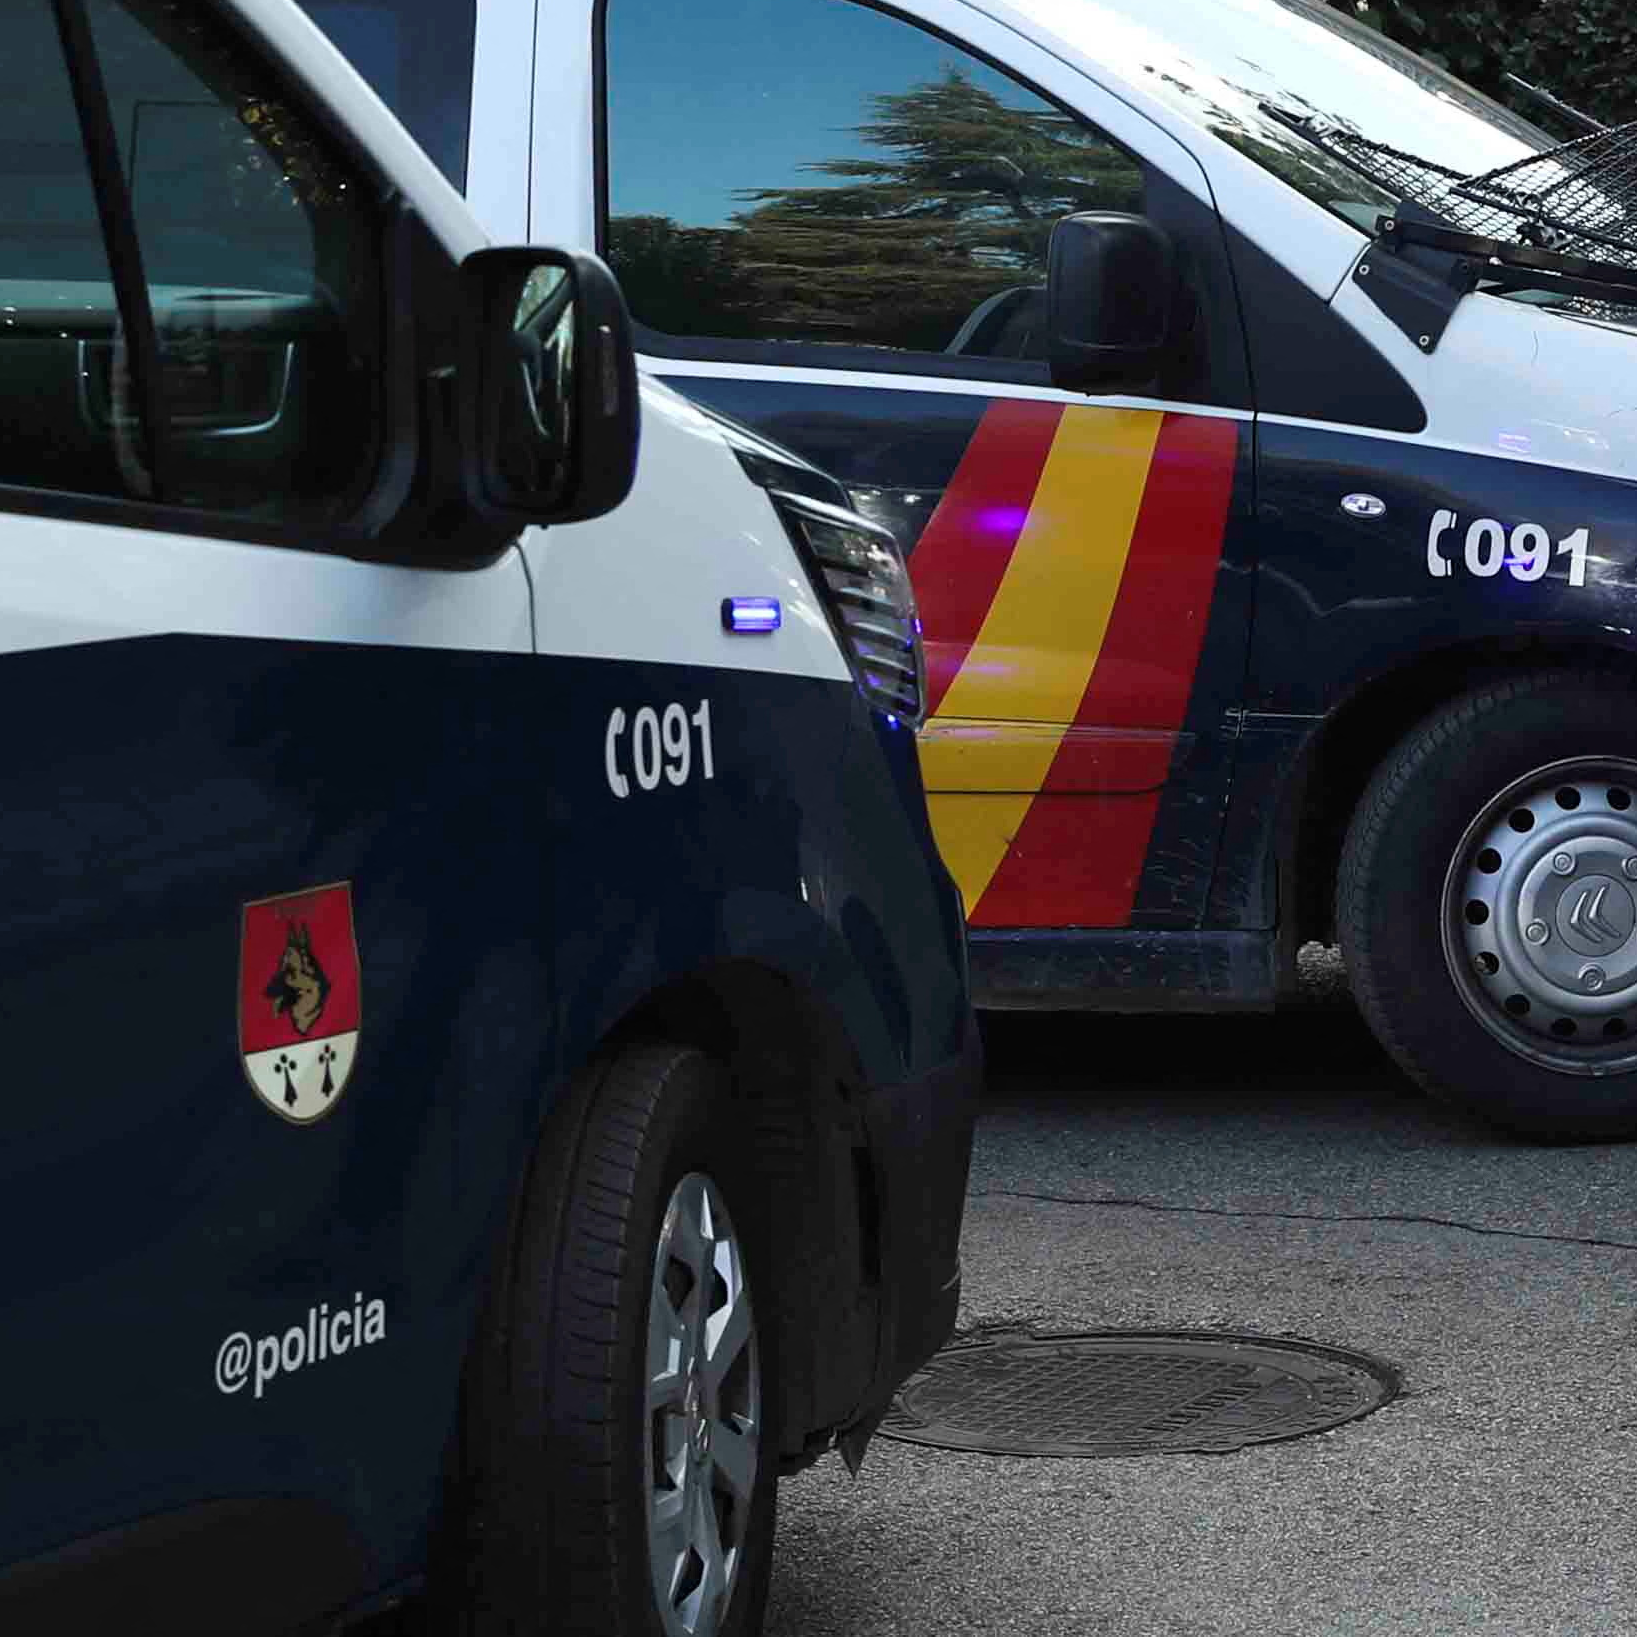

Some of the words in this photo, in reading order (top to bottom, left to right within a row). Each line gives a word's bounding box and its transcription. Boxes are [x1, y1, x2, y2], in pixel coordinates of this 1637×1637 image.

[1464, 518, 1589, 587] 091
[632, 698, 714, 790] 091
[215, 1292, 385, 1397] @policia
